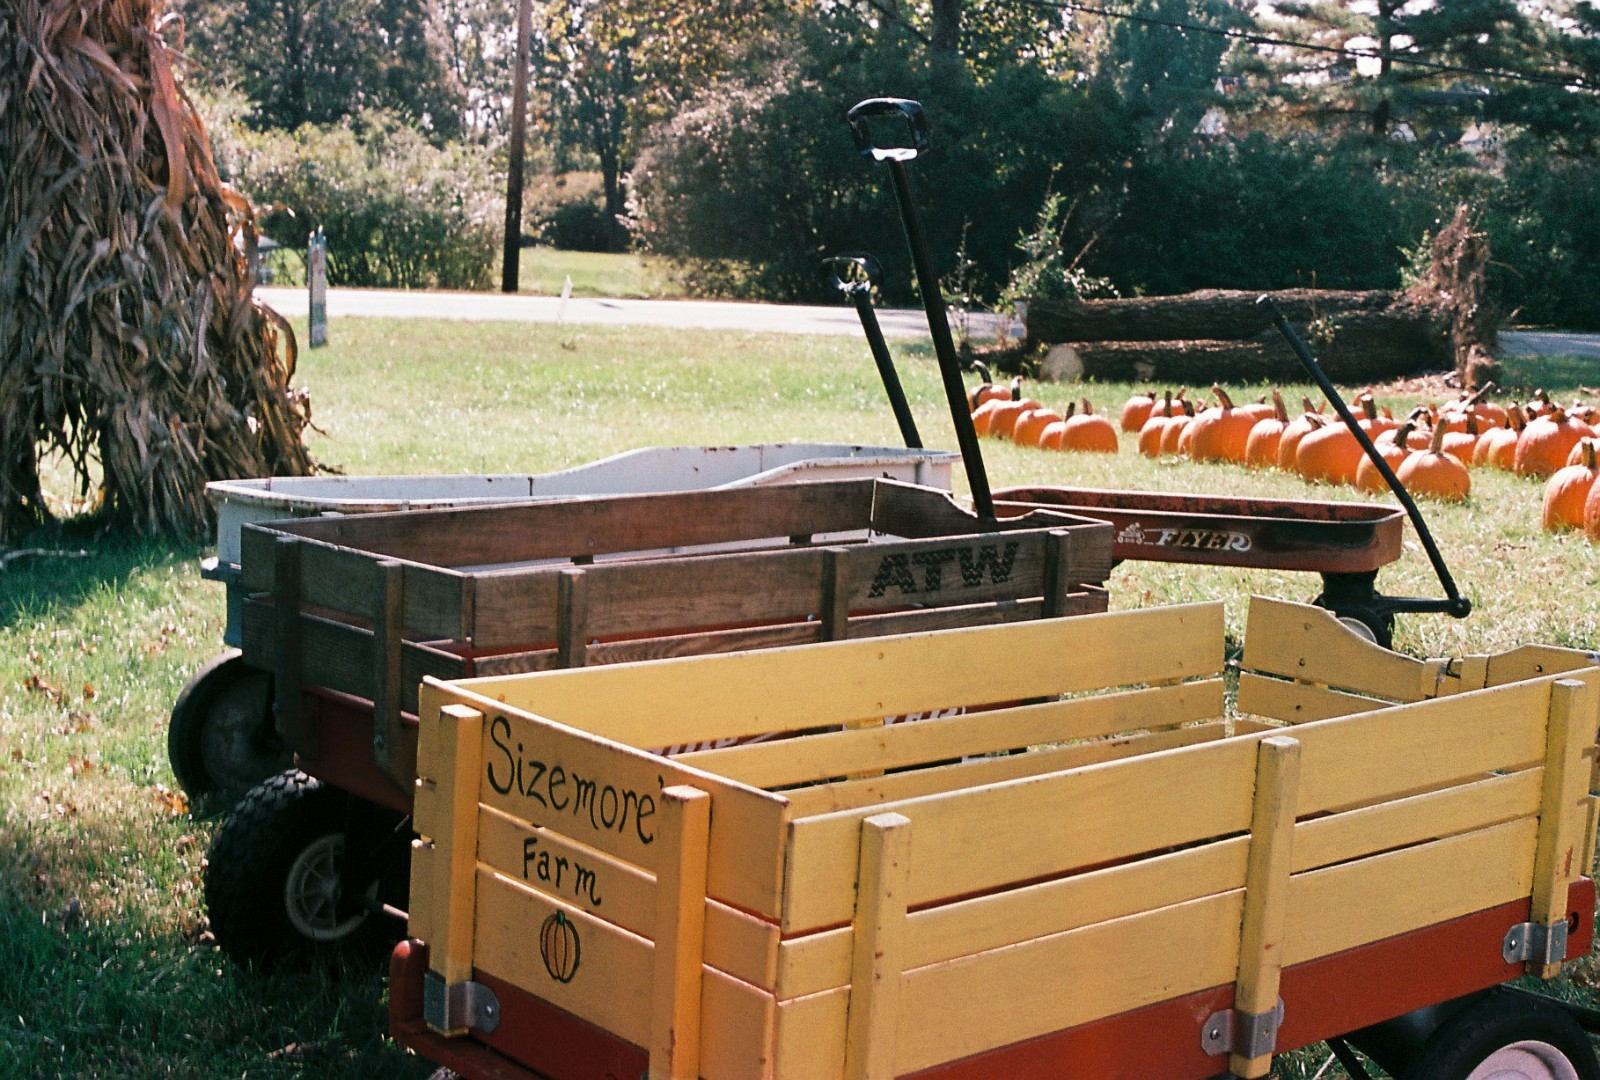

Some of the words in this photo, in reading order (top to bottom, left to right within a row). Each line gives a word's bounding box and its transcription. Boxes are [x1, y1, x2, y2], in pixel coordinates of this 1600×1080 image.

[1156, 528, 1252, 552] FLYER
[867, 541, 1020, 598] ATW
[522, 836, 602, 906] Farm
